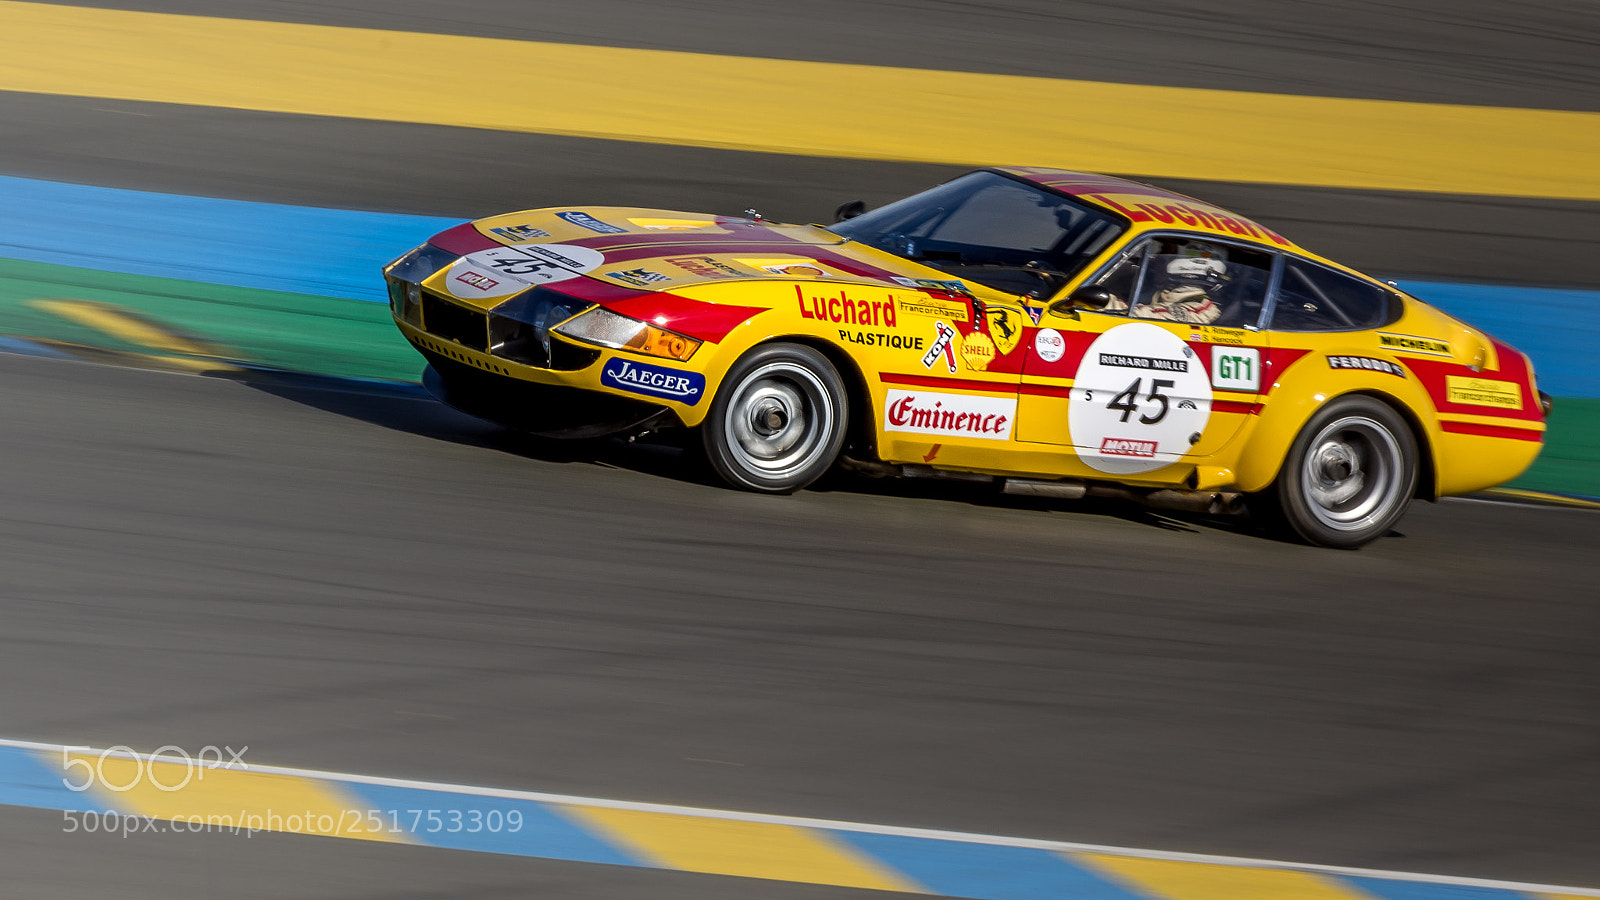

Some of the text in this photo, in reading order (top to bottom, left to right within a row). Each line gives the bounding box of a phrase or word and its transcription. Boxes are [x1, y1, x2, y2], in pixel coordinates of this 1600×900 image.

[490, 258, 558, 275] 45
[795, 285, 897, 328] Luchard
[900, 302, 966, 321] Francorchamps
[838, 329, 924, 350] PLASTIQUE
[923, 326, 955, 368] KONI
[964, 343, 991, 357] SHELL
[1379, 335, 1450, 353] MICHELIN
[1101, 354, 1187, 371] RICHARD MILLE
[1219, 354, 1253, 381] GT1
[608, 361, 698, 395] JAEGER
[1083, 376, 1175, 425] 5 45
[888, 395, 1008, 434] Eminence
[1102, 439, 1155, 455] MOTUL
